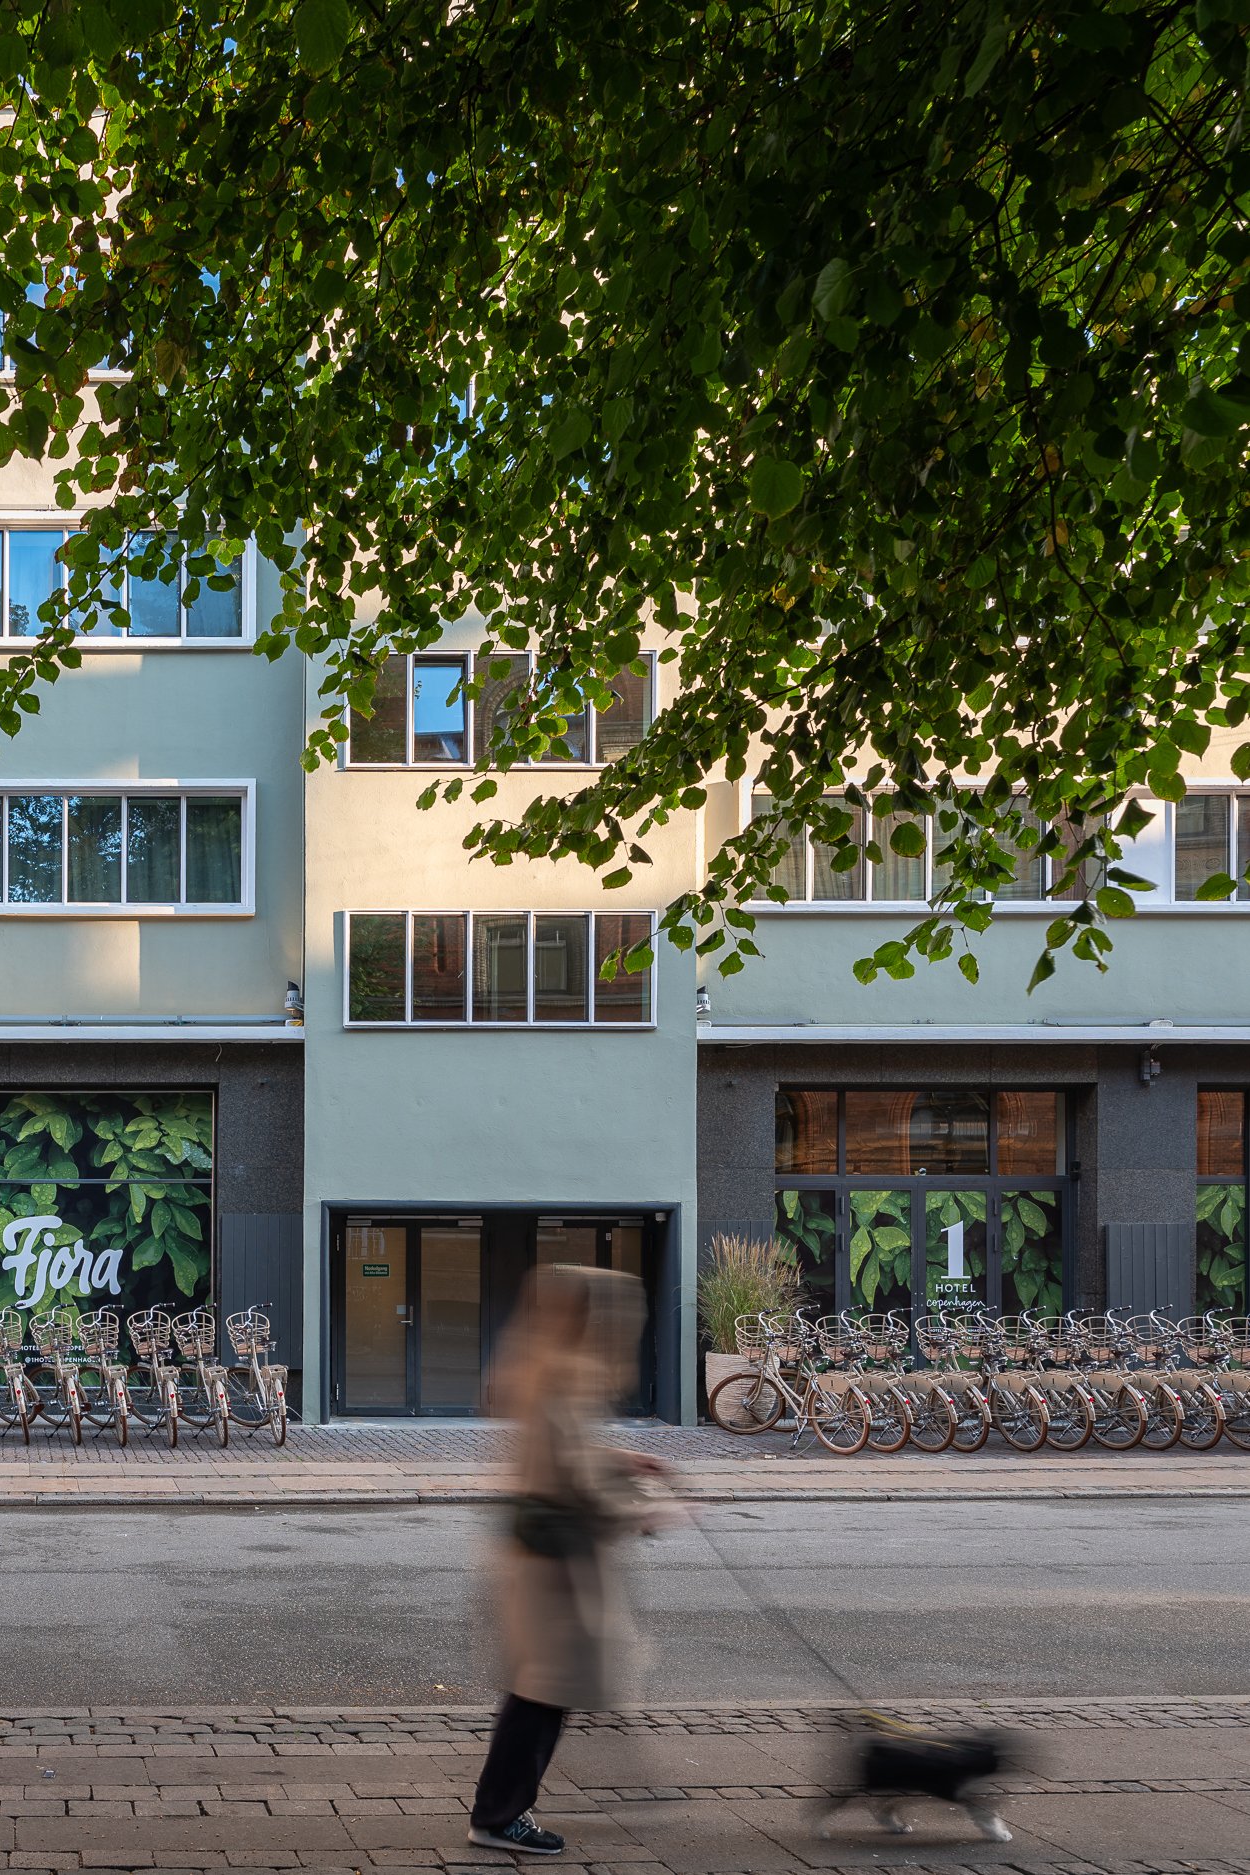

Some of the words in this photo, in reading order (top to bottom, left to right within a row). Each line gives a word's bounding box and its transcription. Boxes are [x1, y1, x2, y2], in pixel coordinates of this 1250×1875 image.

[940, 1220, 971, 1279] 1
[2, 1215, 124, 1309] Fjora
[935, 1284, 976, 1293] HOTEL
[926, 1295, 986, 1312] copenhagen
[504, 1820, 530, 1841] N
